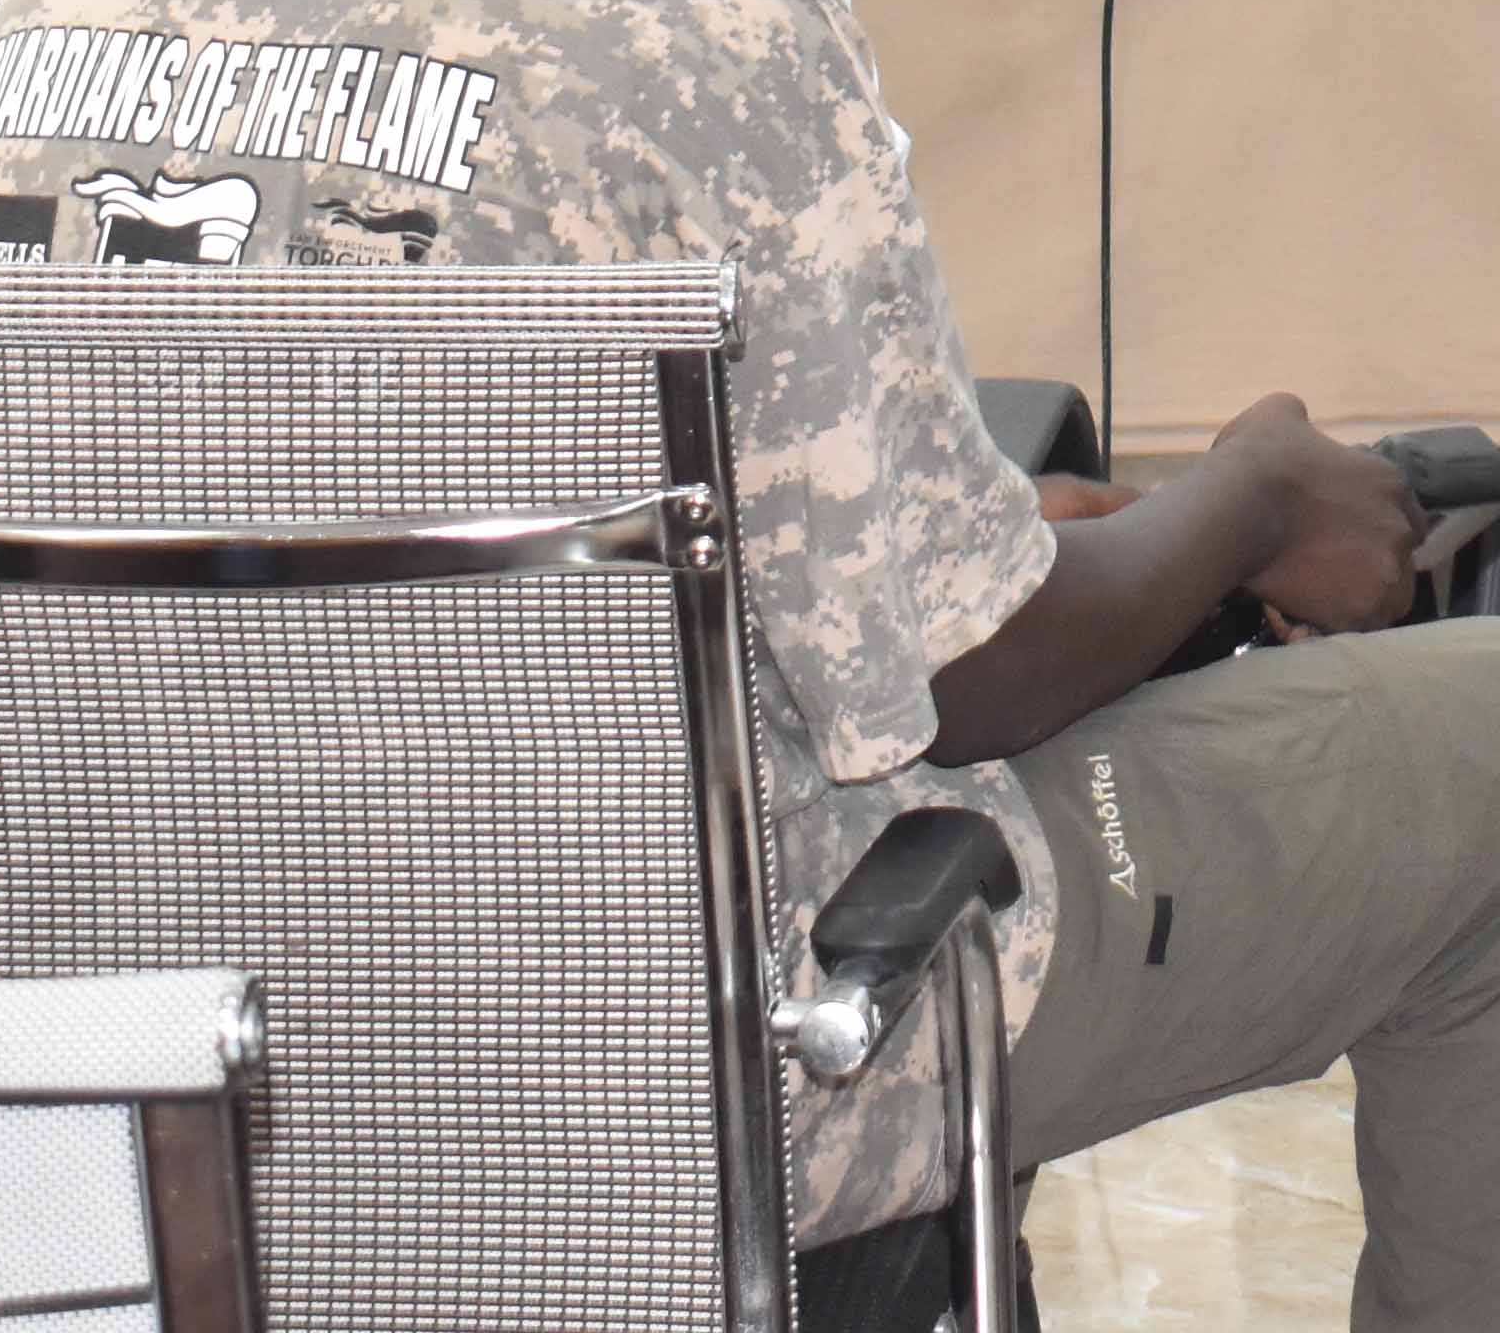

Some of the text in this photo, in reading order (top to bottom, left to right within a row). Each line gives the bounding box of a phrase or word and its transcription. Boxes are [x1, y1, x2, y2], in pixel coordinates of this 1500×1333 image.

[171, 37, 254, 153] OF
[231, 43, 334, 160] THE
[311, 43, 499, 195] FLAME
